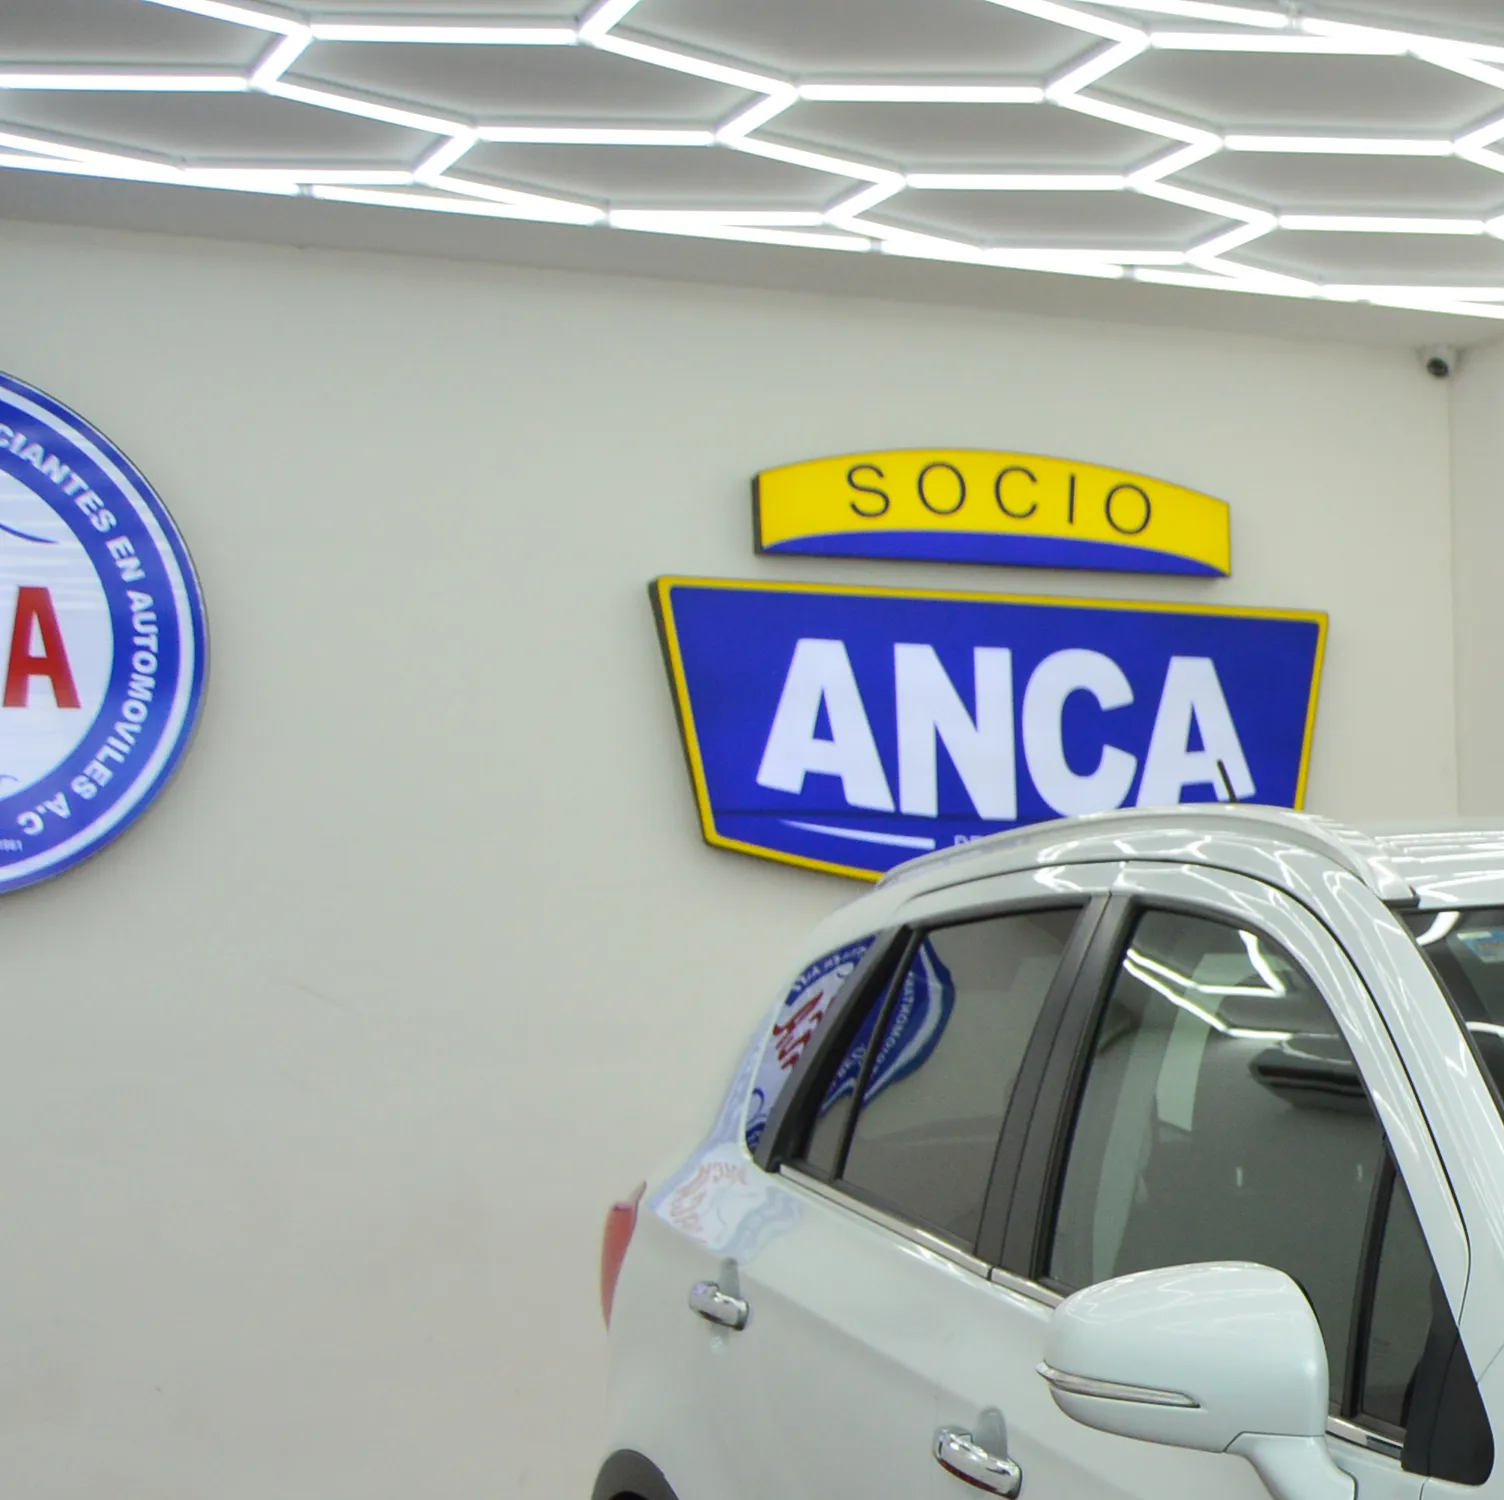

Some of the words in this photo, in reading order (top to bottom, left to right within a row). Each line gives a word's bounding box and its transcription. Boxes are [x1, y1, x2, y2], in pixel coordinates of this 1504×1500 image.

[106, 536, 144, 583] EN
[848, 463, 1153, 535] SOCIO
[72, 590, 160, 800] AUTOMOVILES
[756, 638, 1256, 820] ANCA
